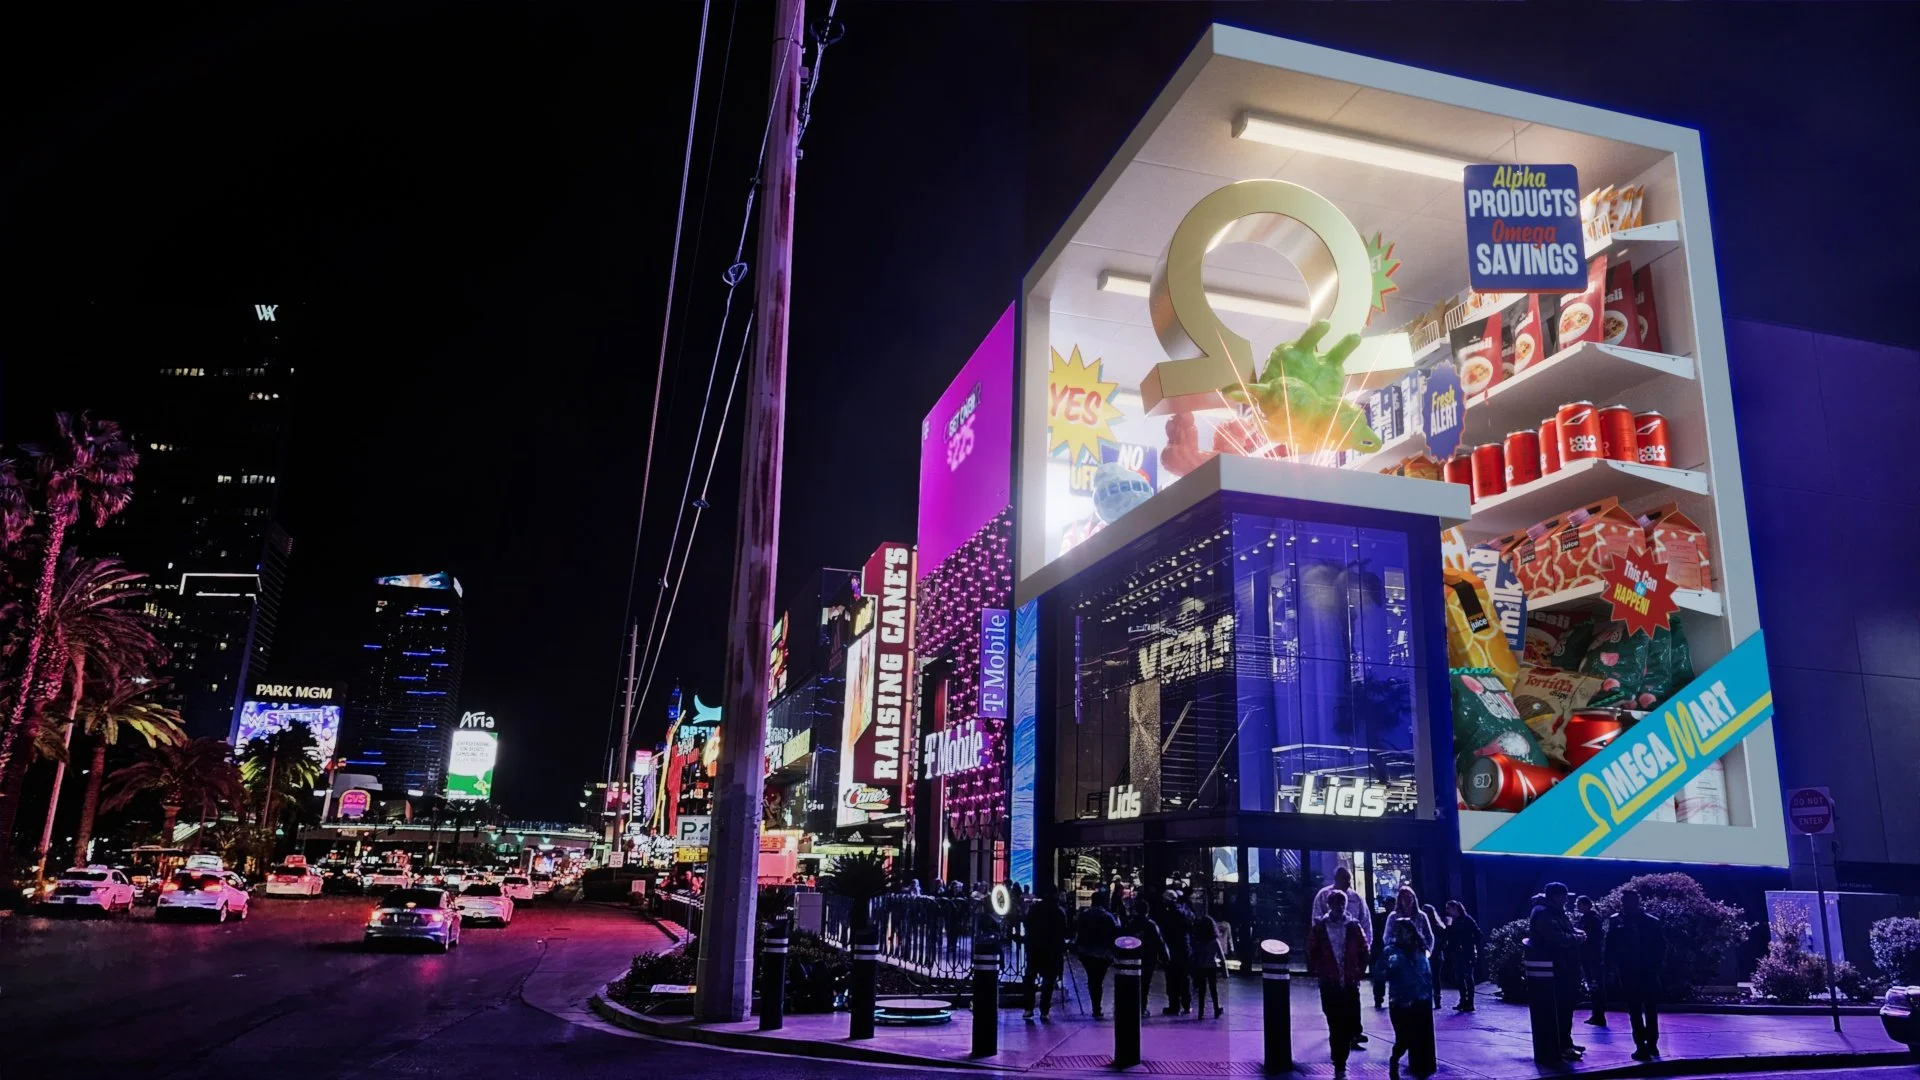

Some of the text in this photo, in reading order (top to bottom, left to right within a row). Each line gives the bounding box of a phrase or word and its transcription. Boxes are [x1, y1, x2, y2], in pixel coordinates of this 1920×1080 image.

[1493, 166, 1546, 193] Alpha
[1468, 188, 1578, 218] PRODUCTS
[1492, 219, 1557, 250] Omega
[1476, 242, 1579, 276] SAVINGS
[1050, 382, 1101, 426] YES
[1432, 384, 1456, 410] Fresh
[1431, 401, 1458, 437] ALERT
[1570, 443, 1598, 452] COLA
[1640, 453, 1667, 462] COLA
[1624, 560, 1658, 592] This Can
[1494, 579, 1523, 635] milk
[873, 547, 909, 780] RAISING CANE'S
[256, 683, 333, 700] PARK MGM
[1525, 674, 1573, 693] Tortilla
[459, 711, 495, 729] Aria
[344, 793, 367, 804] CVS
[632, 774, 644, 817] ROSS
[845, 787, 891, 809] Cane's
[1107, 784, 1142, 820] Lids
[1301, 773, 1386, 818] Lids
[1799, 816, 1824, 826] ENTER
